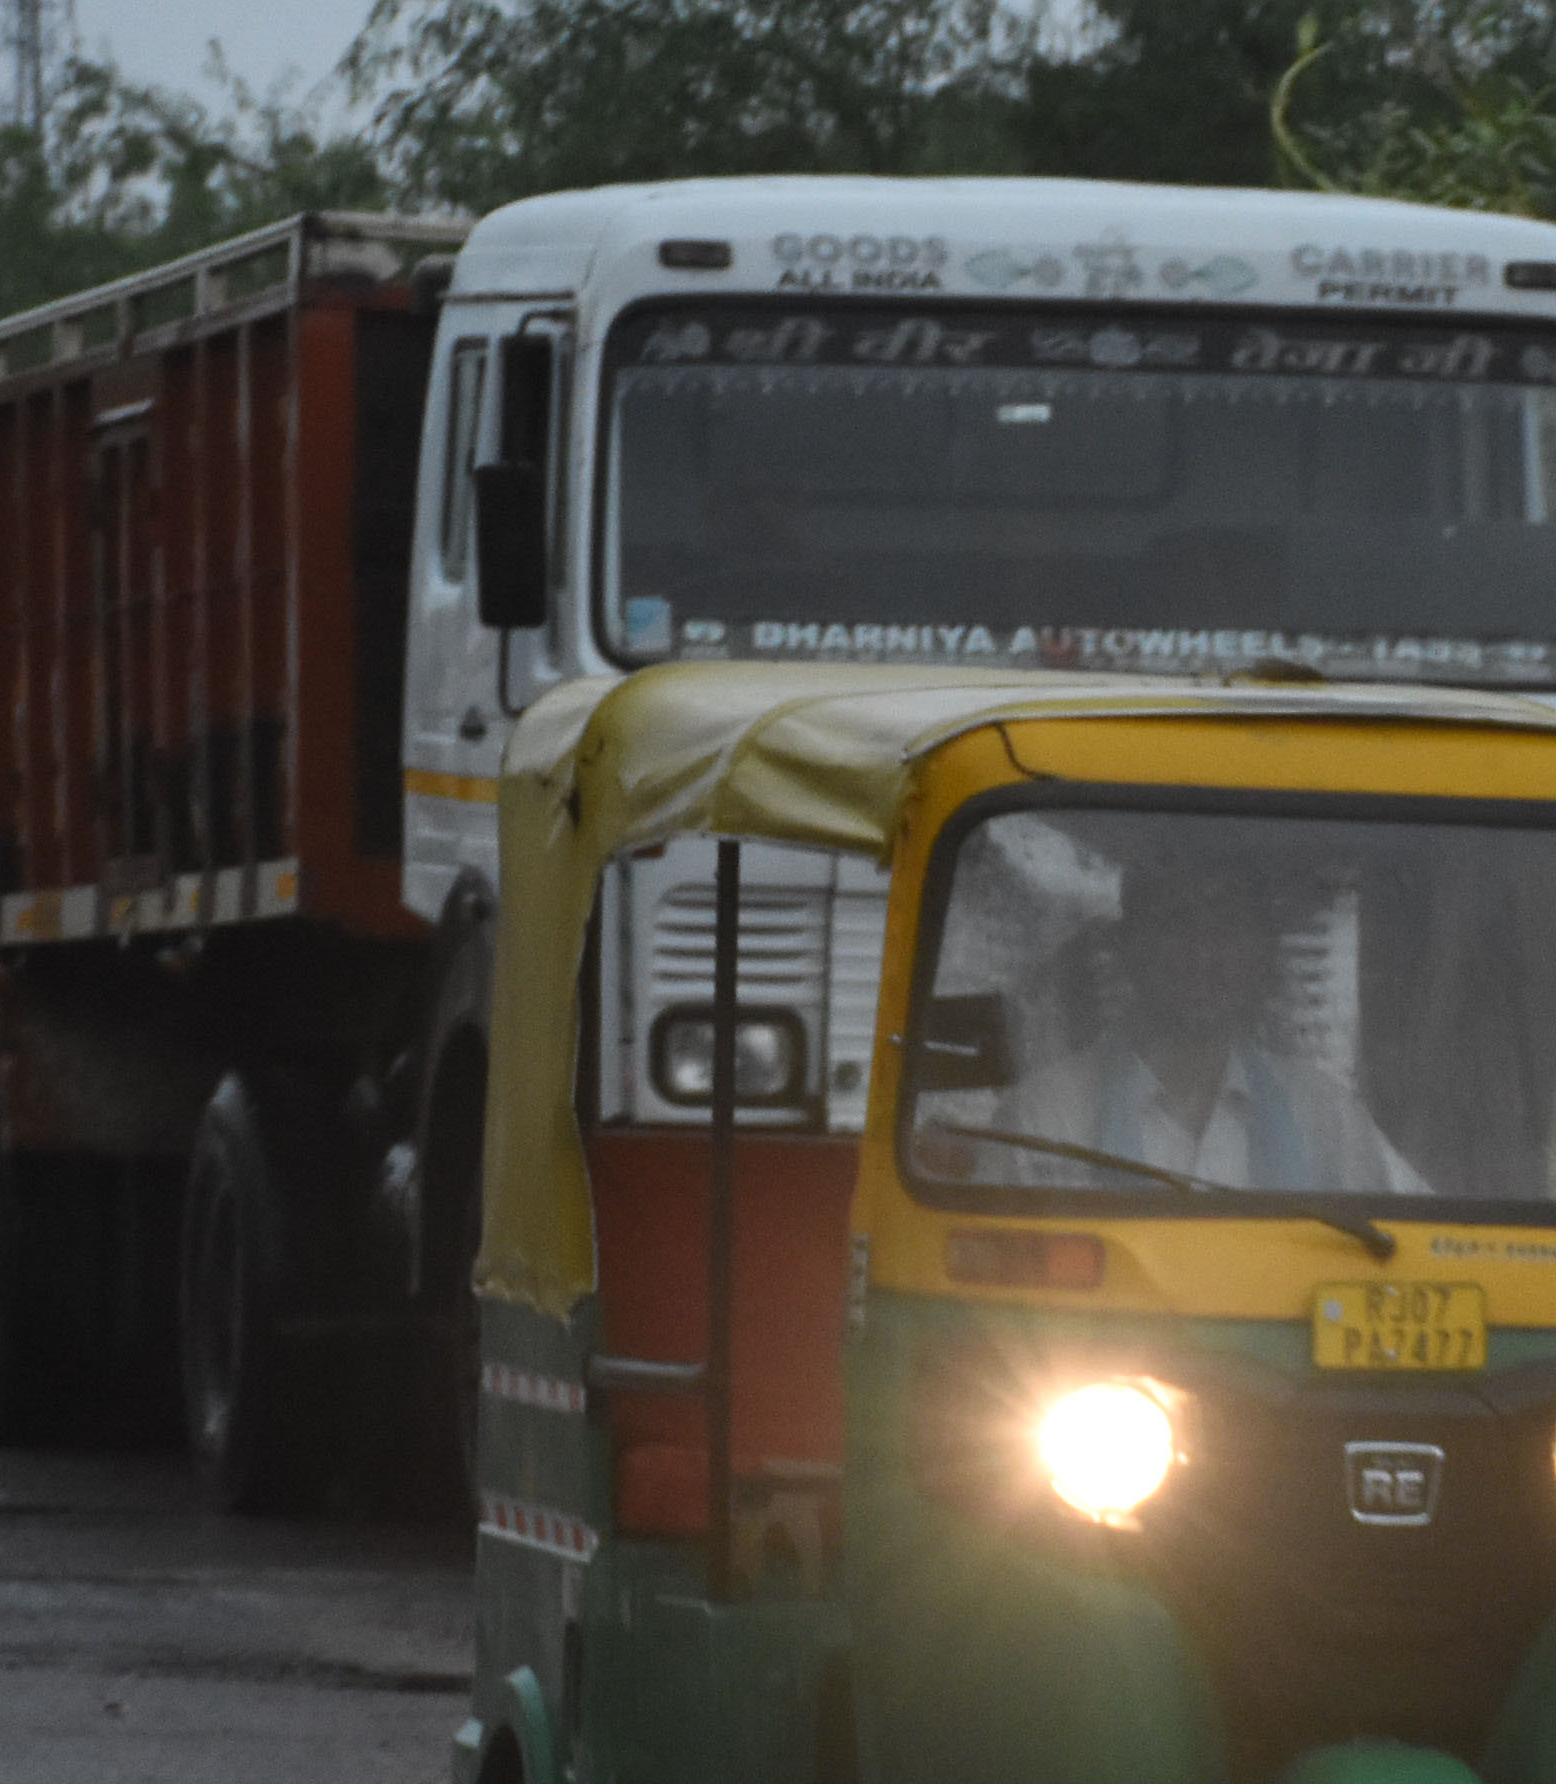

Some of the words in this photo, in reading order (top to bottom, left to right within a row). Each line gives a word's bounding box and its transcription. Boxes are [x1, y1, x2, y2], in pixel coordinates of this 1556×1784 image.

[772, 233, 948, 264] GOODS
[1291, 244, 1491, 284] CARRIER
[777, 268, 843, 290] ALL
[852, 269, 942, 291] INDIA
[1318, 279, 1459, 305] PERMIT
[1008, 625, 1325, 661] AUTOWHEELS
[1366, 1282, 1451, 1323] RJ07
[1343, 1327, 1474, 1365] PA7477
[1362, 1468, 1425, 1507] RE
